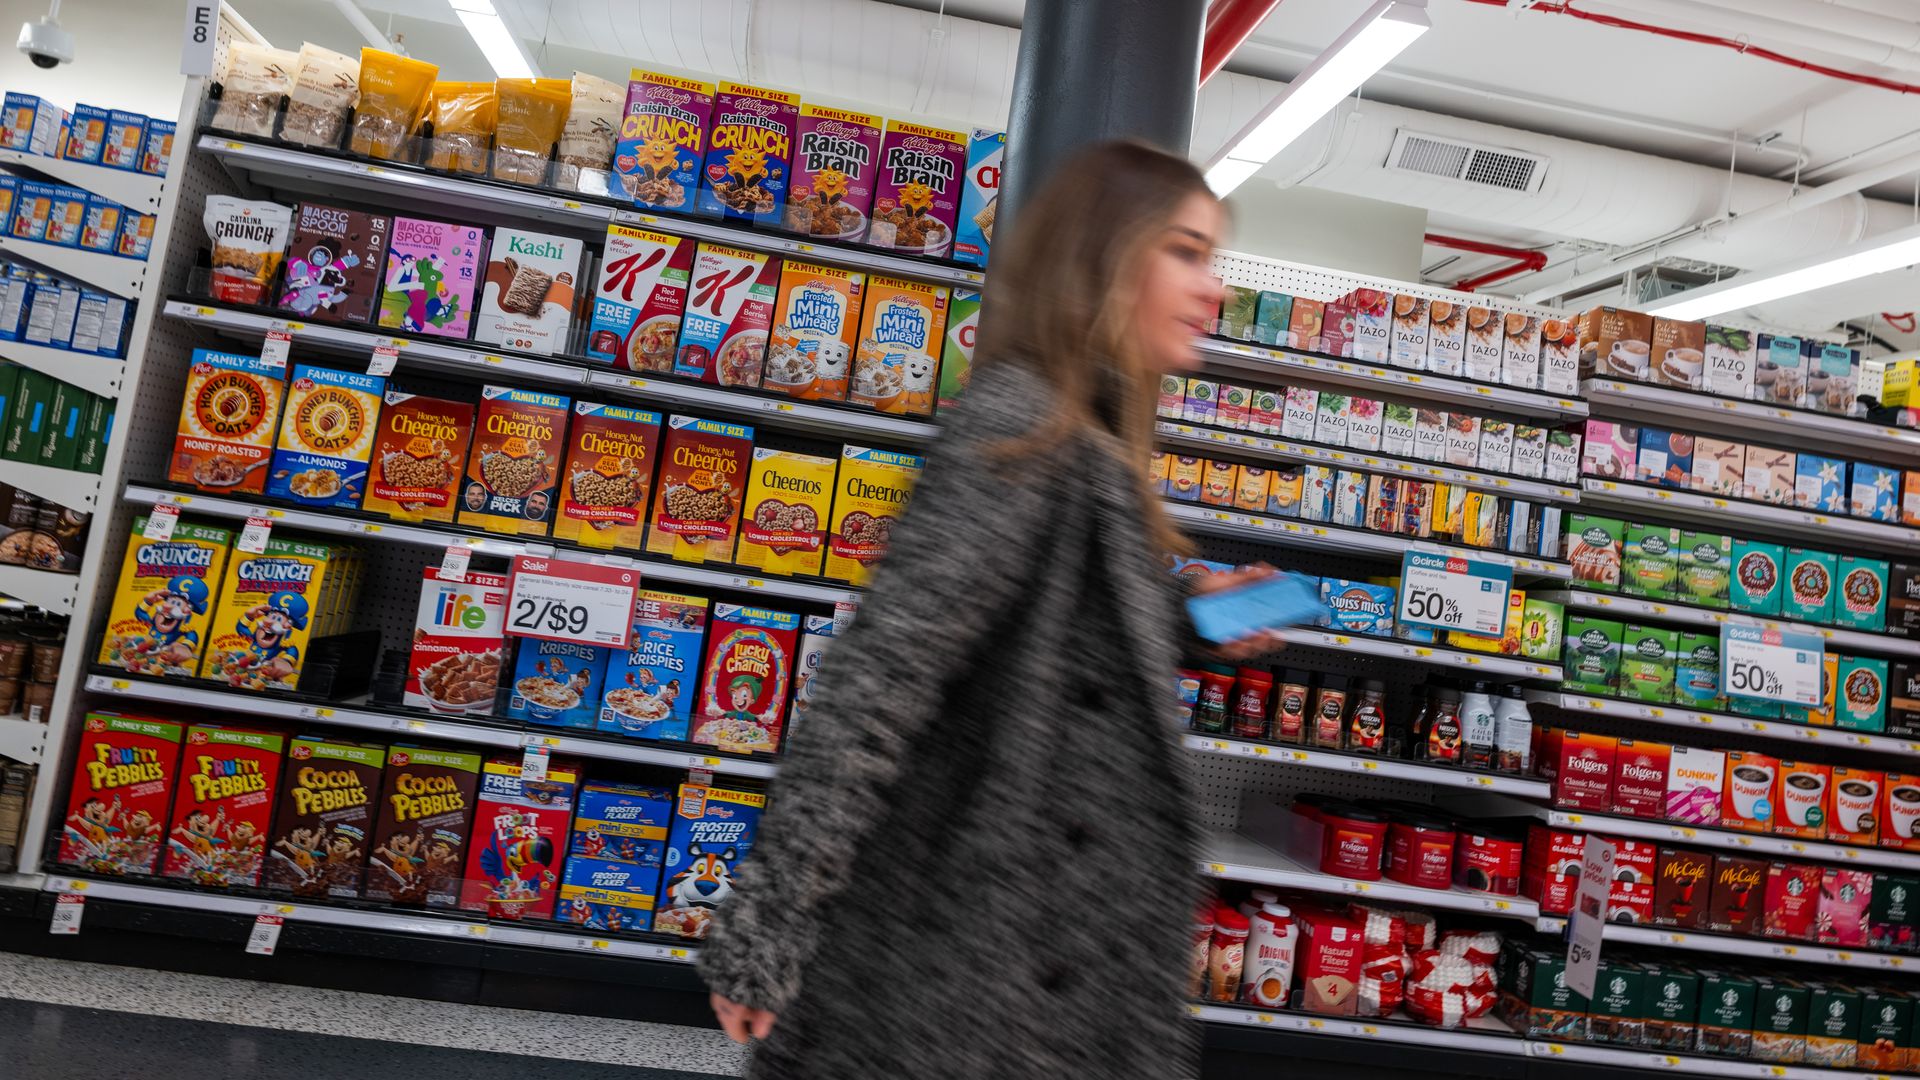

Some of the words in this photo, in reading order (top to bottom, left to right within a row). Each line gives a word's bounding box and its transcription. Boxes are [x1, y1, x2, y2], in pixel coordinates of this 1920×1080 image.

[642, 73, 678, 86] FAMILY
[680, 80, 702, 91] SIZE
[646, 86, 690, 104] Kellogg's
[730, 86, 766, 98] FAMILY
[768, 92, 789, 102] SIZE
[632, 102, 670, 117] Raisin
[671, 107, 700, 126] Bran
[621, 115, 702, 152] CRUNCH
[711, 126, 790, 160] CRUNCH
[801, 132, 870, 164] Raisin
[805, 152, 860, 180] Bran
[230, 214, 262, 226] CATALINA
[302, 206, 349, 222] MAGIC
[396, 232, 442, 246] SPOON
[468, 230, 476, 240] 0
[508, 236, 564, 260] Kashi
[460, 267, 472, 278] 13
[603, 248, 666, 302] K
[700, 264, 720, 272] SPECIAL
[692, 265, 754, 316] K
[744, 309, 766, 320] Berries
[750, 302, 764, 311] Red
[797, 300, 839, 320] Mini
[791, 314, 838, 335] Wheats
[706, 331, 718, 340] tote
[1397, 332, 1424, 345] TAZO
[1433, 338, 1461, 351] TAZO
[1471, 344, 1498, 357] TAZO
[205, 353, 246, 368] FAMILY
[1508, 350, 1536, 363] TAZO
[1711, 356, 1746, 373] TAZO
[200, 380, 226, 409] HONEY
[229, 376, 260, 418] BUNCHES
[391, 414, 458, 440] Cheerios
[417, 412, 435, 425] Honey
[436, 416, 456, 426] Nut
[215, 420, 250, 436] OATS
[697, 420, 725, 433] FAMILY
[727, 426, 744, 436] SIZE
[184, 440, 218, 454] HONEY
[218, 444, 262, 458] ROASTED
[298, 454, 348, 471] ALMONDS
[674, 447, 737, 474] Cheerios
[490, 502, 520, 514] PICK
[748, 532, 768, 541] LOWER
[770, 536, 810, 544] CHOLESTEROL
[136, 544, 214, 566] CRUNCH
[522, 560, 548, 572] Sale!
[1420, 557, 1444, 568] circle
[1446, 560, 1468, 572] deals
[435, 592, 486, 630] life
[1408, 590, 1444, 620] 50
[1446, 599, 1458, 612] %
[514, 599, 588, 634] 2/$9
[1444, 612, 1462, 624] off
[1738, 631, 1760, 640] circle
[540, 641, 594, 661] KRISPIES
[643, 640, 675, 656] RICE
[734, 643, 770, 664] Lucky
[629, 654, 684, 672] KRISPIES
[726, 657, 770, 678] Charms
[1732, 662, 1764, 692] 50
[1766, 670, 1778, 684] %
[1766, 684, 1783, 695] off
[94, 742, 158, 766] FRUITY
[197, 755, 260, 777] FRUITY
[1568, 757, 1608, 775] Folgers
[86, 761, 164, 792] PEBBLES
[298, 766, 360, 790] COCOA
[484, 773, 522, 790] FREE
[1676, 768, 1718, 782] DUNKIN'
[190, 773, 267, 804] PEBBLES
[484, 786, 505, 796] Cereal
[1564, 776, 1586, 790] Classic
[1588, 780, 1608, 792] Roast
[291, 786, 368, 816] PEBBLES
[604, 806, 642, 814] FROSTED
[605, 812, 638, 820] FLAKES
[494, 814, 540, 830] FROOT
[690, 822, 746, 832] FROSTED
[498, 824, 538, 841] LOOPS
[691, 832, 740, 842] FLAKES
[1340, 841, 1368, 854] Folgers
[670, 852, 677, 860] 6
[592, 872, 630, 880] FROSTED
[1664, 861, 1706, 879] McCafé
[592, 878, 625, 887] FLAKES
[585, 890, 609, 900] mini
[1258, 944, 1291, 961] ORIGINAL
[1320, 944, 1354, 958] Natural
[1321, 956, 1350, 968] Filters
[1330, 984, 1338, 997] 4
